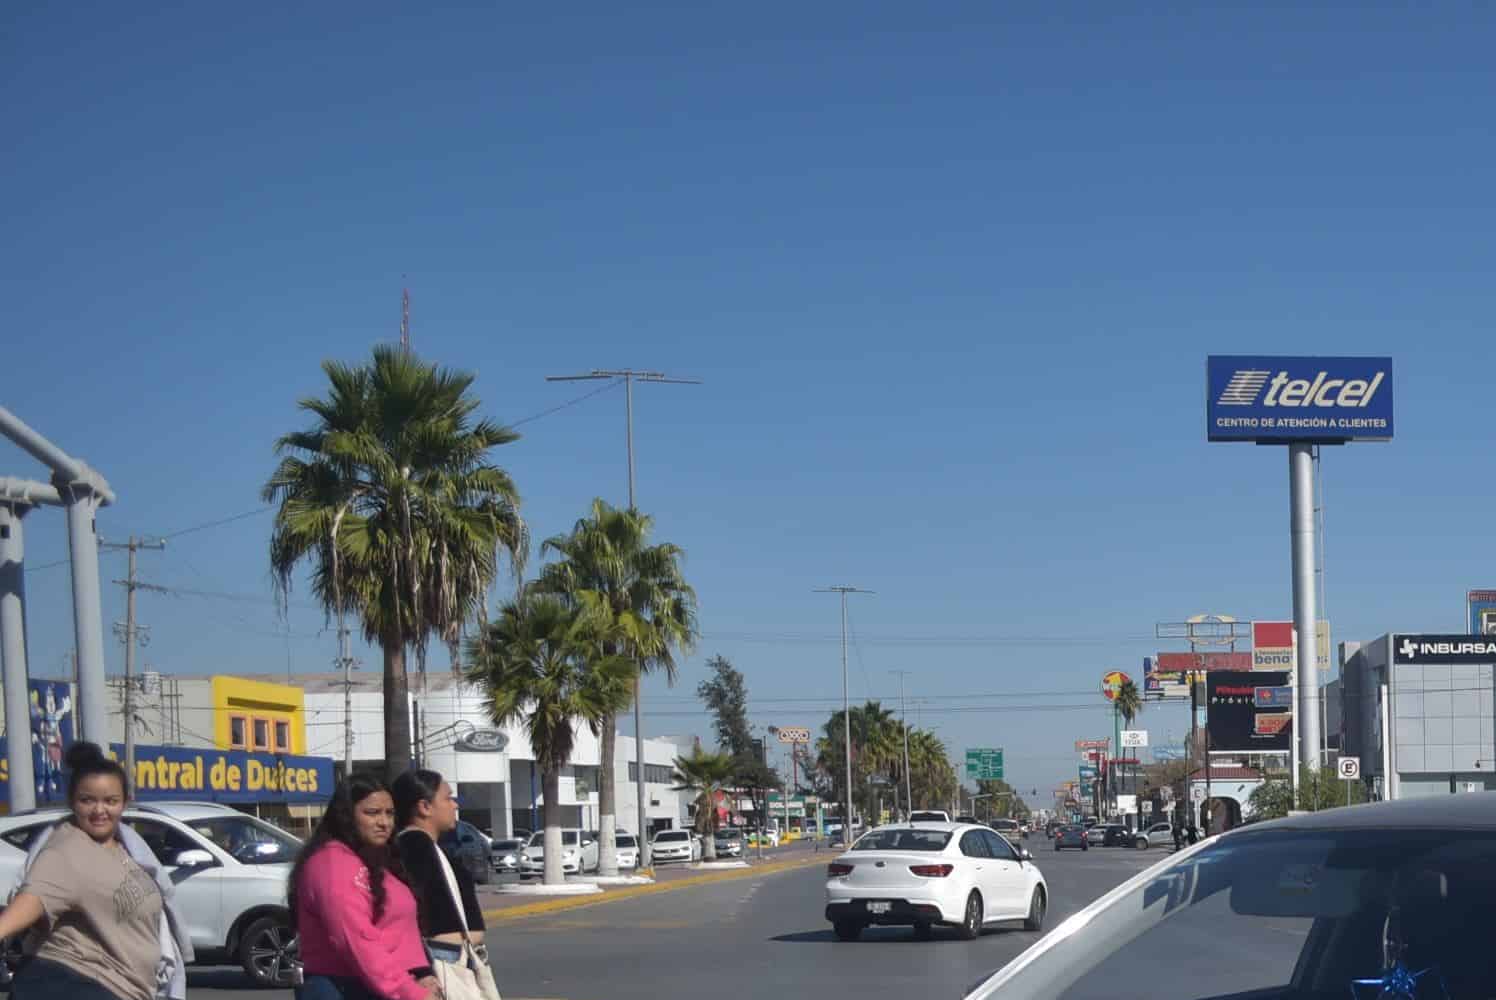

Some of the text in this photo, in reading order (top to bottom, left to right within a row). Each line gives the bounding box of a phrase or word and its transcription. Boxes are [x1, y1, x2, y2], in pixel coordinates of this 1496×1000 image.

[1264, 371, 1384, 407] telcel
[1216, 416, 1387, 428] CENTRO DE ATENCIÓN A CLIENTES
[109, 753, 318, 792] ntral de Dulces
